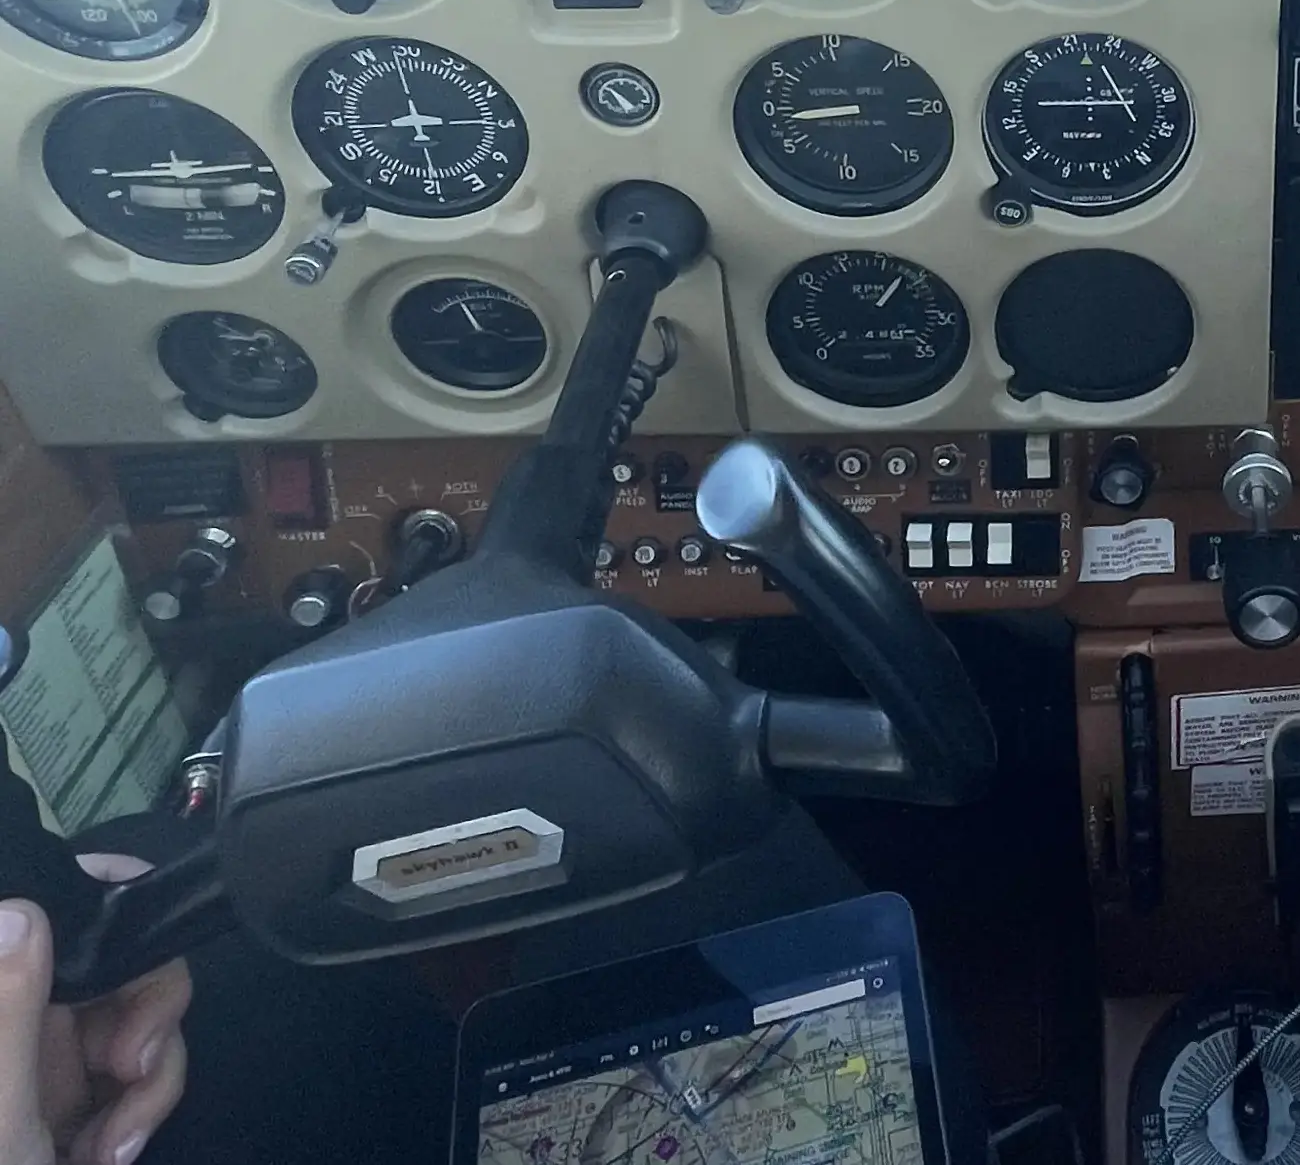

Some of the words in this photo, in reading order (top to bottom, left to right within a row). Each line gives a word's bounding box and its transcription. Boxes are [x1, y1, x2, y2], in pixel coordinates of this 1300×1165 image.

[822, 35, 841, 48] 10
[1105, 35, 1122, 49] 24
[351, 48, 377, 66] W
[894, 53, 911, 67] 15
[1025, 50, 1040, 63] S
[1141, 53, 1161, 70] W
[771, 62, 784, 77] 5
[325, 68, 348, 95] 24
[1003, 79, 1018, 94] 15
[1161, 87, 1177, 103] 30
[763, 101, 775, 116] 0
[922, 100, 943, 114] 20
[324, 111, 344, 126] 21
[498, 118, 516, 129] 3
[1002, 116, 1018, 131] 12
[1158, 121, 1175, 138] 33
[339, 142, 363, 161] S
[783, 138, 796, 154] 5
[492, 151, 508, 164] 6
[903, 149, 920, 163] 15
[1023, 147, 1038, 161] E
[1136, 151, 1152, 166] N
[378, 169, 398, 186] 15
[839, 165, 857, 180] 10
[1102, 168, 1111, 180] 3
[423, 179, 441, 195] 12
[462, 174, 486, 192] E
[1000, 208, 1021, 219] OBS
[798, 272, 813, 286] 10
[793, 316, 804, 329] 5
[816, 348, 828, 360] 0
[915, 345, 935, 358] 35
[661, 492, 693, 500] AUDIO
[995, 490, 1022, 499] TAXI
[944, 581, 969, 590] NAV
[985, 581, 1009, 589] BCN
[1017, 580, 1059, 590] STROBE
[953, 590, 965, 599] LT
